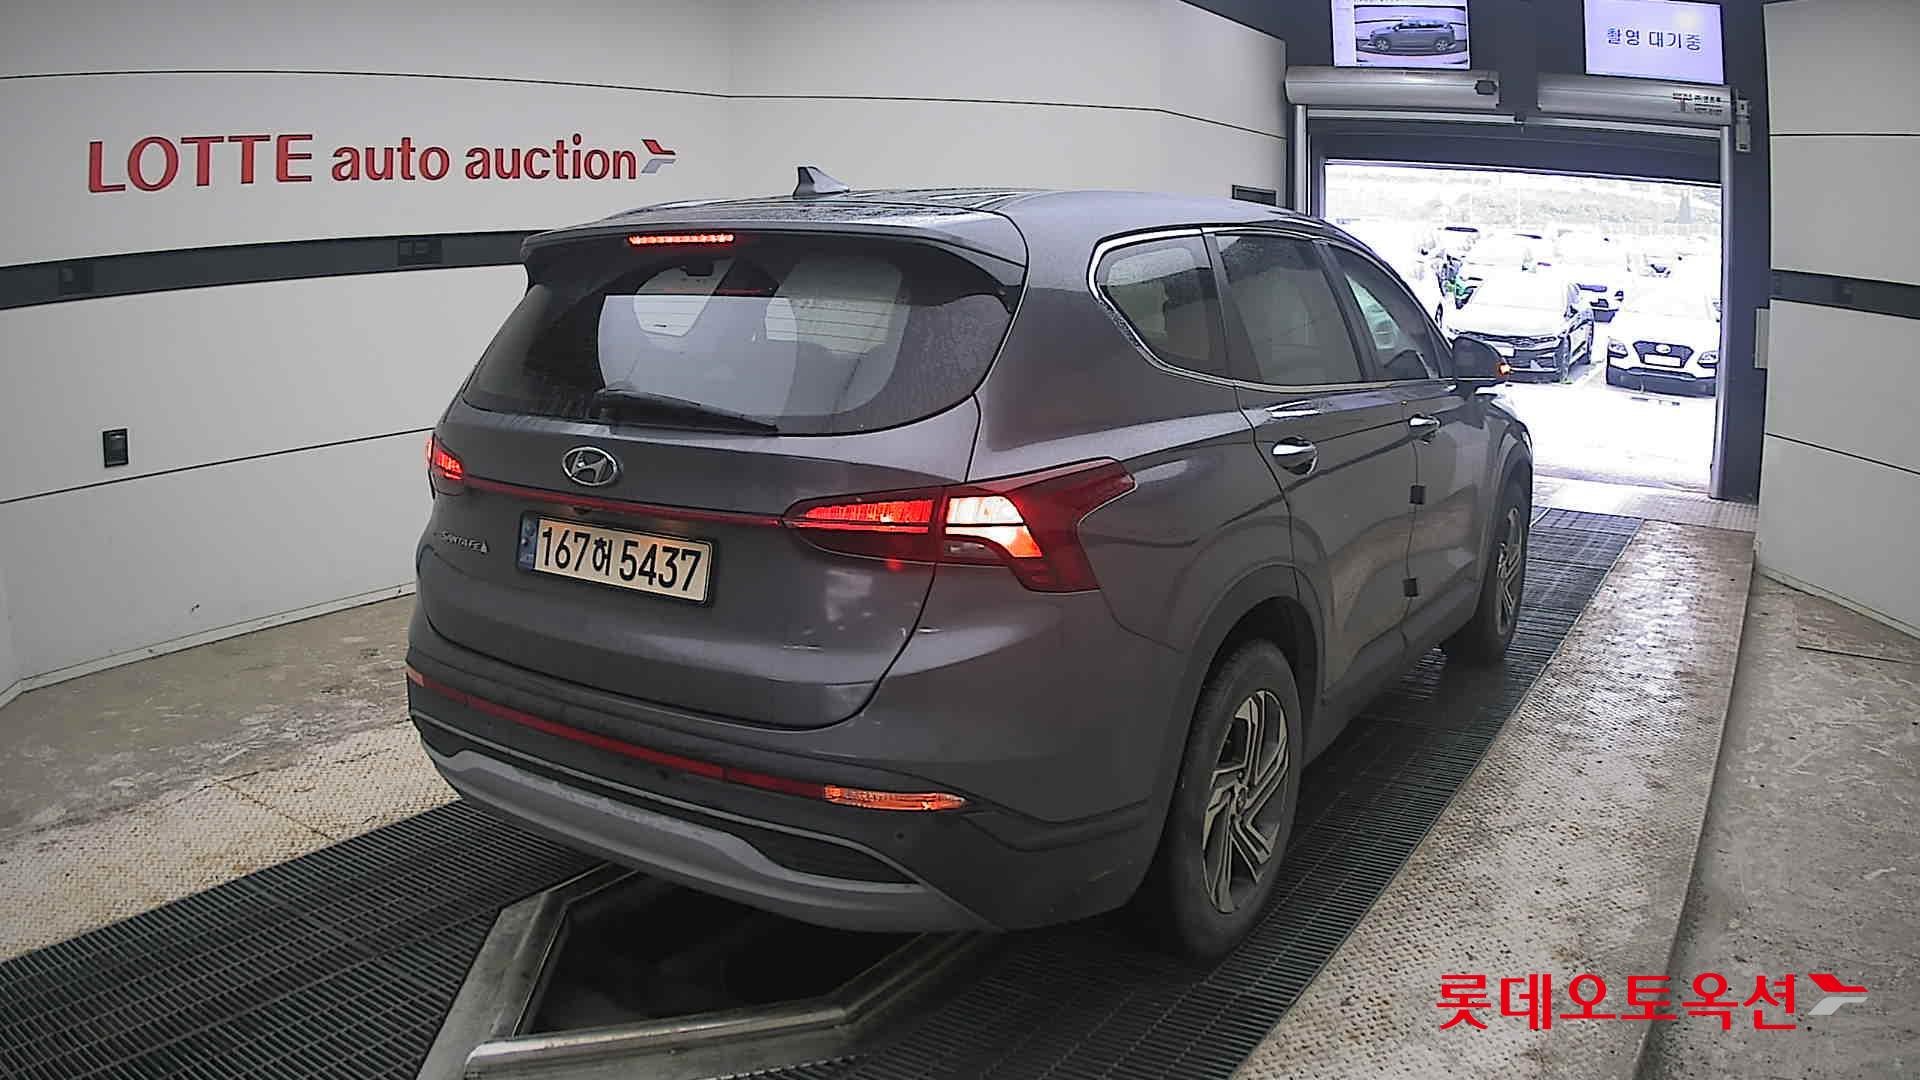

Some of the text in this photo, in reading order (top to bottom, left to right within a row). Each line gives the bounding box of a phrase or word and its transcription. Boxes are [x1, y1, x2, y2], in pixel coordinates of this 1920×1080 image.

[1649, 31, 1701, 51] 대기중
[89, 133, 637, 193] LOTTE auto auction
[542, 526, 702, 592] 167허 5437
